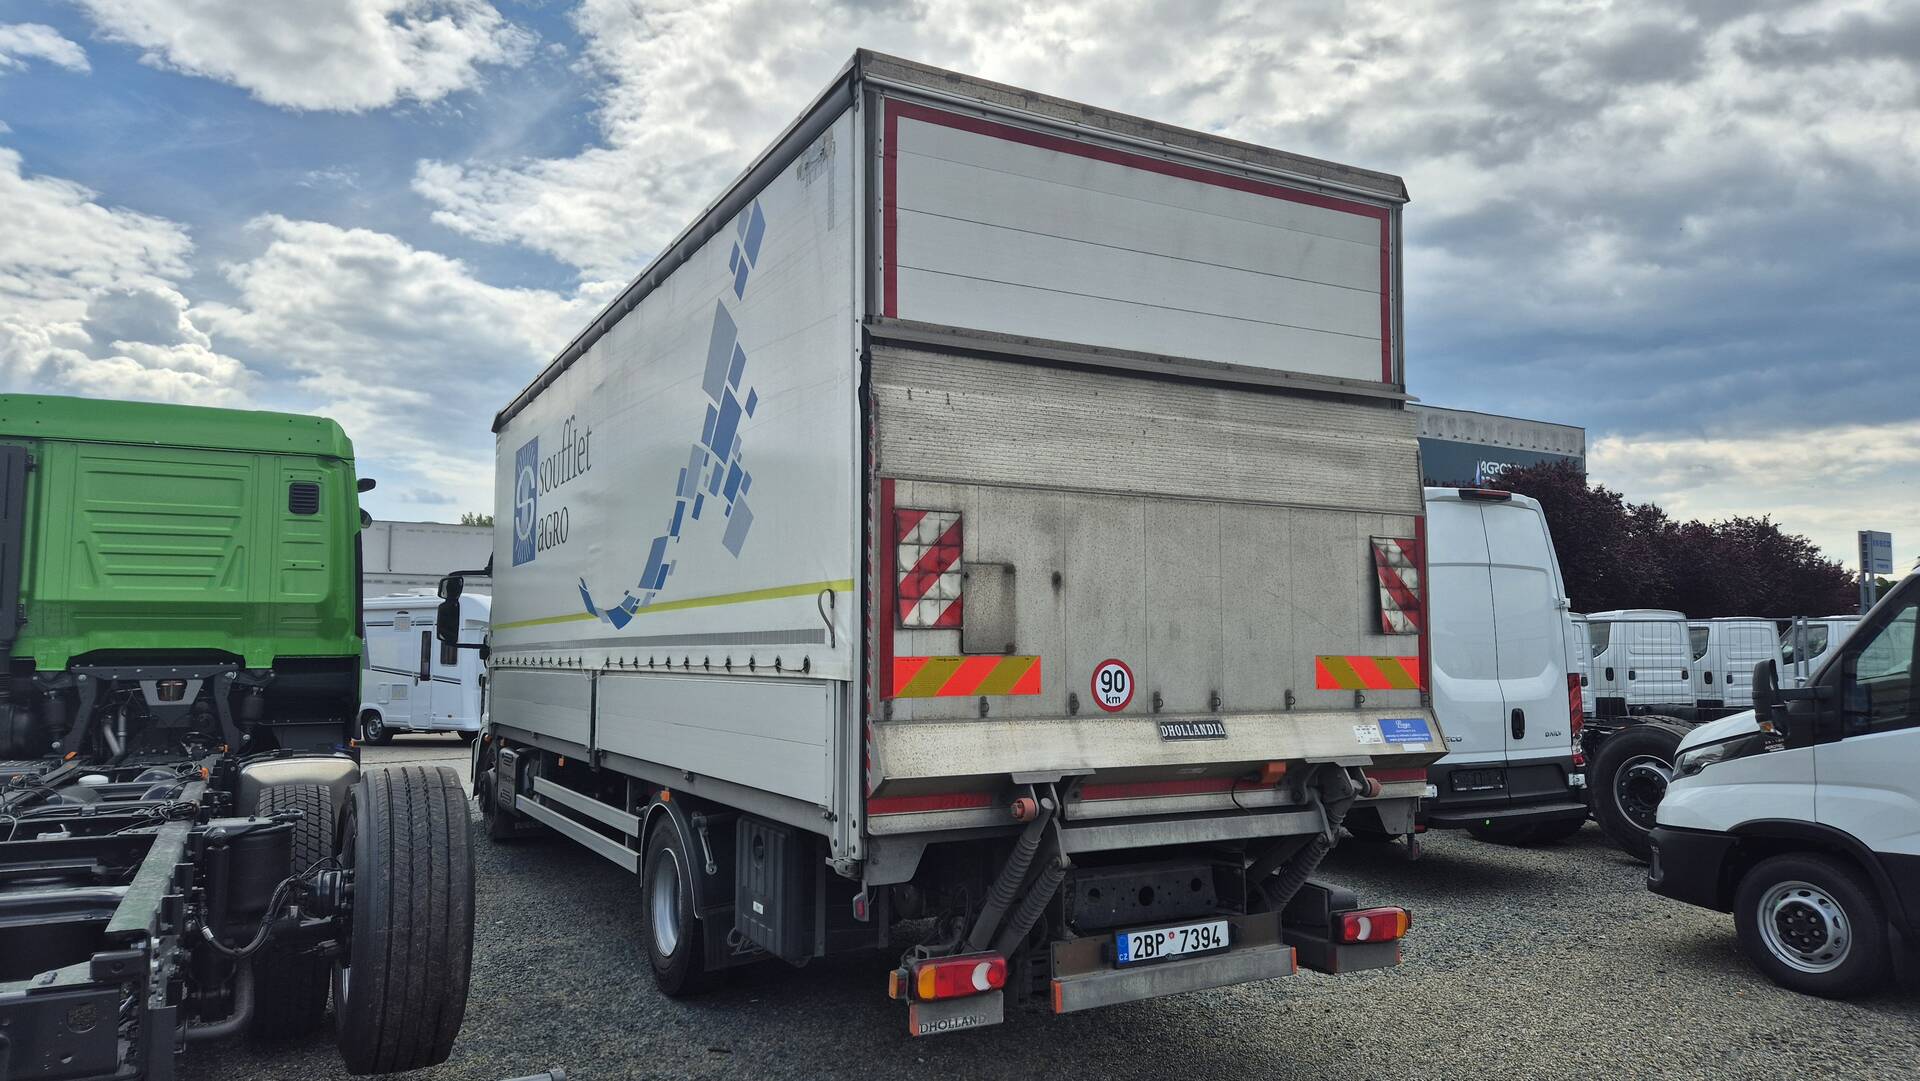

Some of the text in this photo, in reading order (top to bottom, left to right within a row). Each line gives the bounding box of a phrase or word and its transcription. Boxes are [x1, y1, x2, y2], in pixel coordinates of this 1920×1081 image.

[1100, 669, 1125, 693] 90
[1105, 694, 1121, 704] km
[1160, 723, 1226, 737] DHOLLANDIA
[1133, 925, 1221, 959] 2BP 7394
[1119, 953, 1129, 961] CZ
